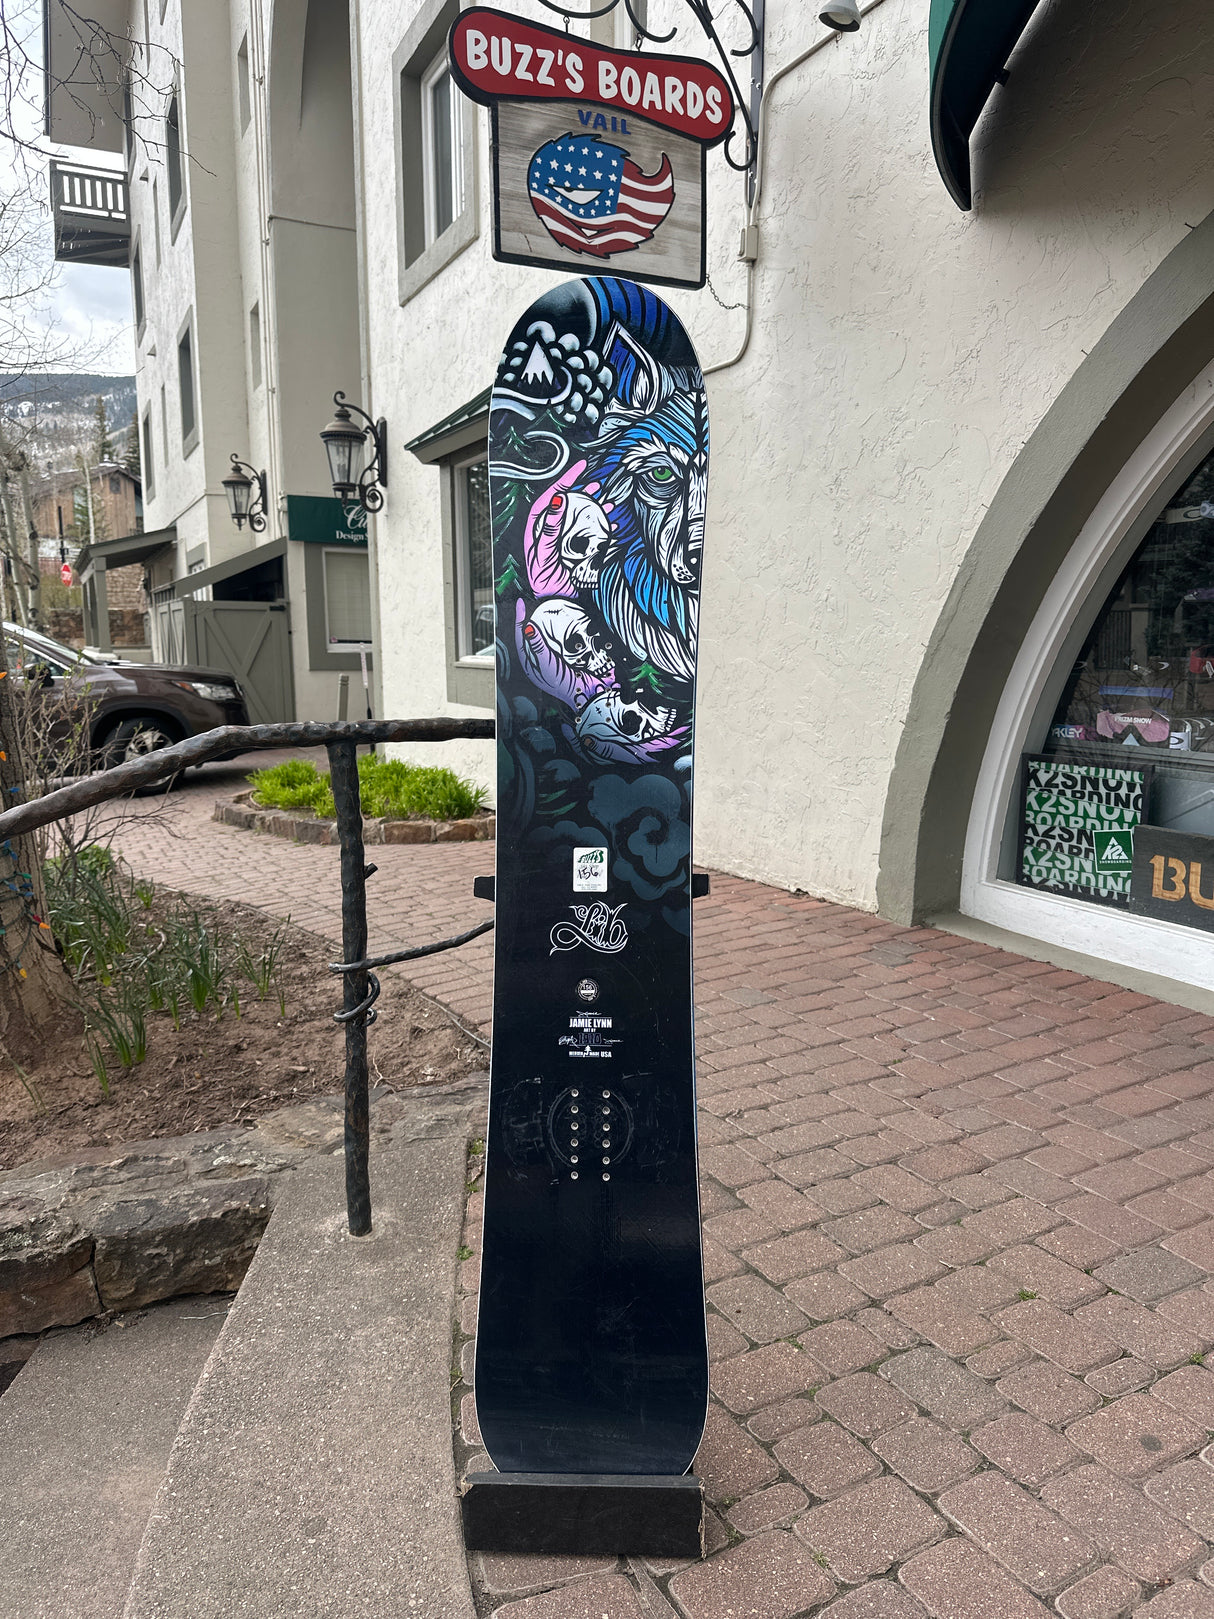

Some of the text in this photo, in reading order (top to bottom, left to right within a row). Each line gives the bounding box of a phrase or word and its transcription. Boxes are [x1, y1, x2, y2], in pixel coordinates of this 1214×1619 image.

[466, 29, 723, 124] BUZZ'S BOARDS
[577, 109, 632, 136] VAIL
[335, 530, 364, 543] Design
[1133, 717, 1152, 725] SNOW
[1051, 726, 1083, 739] AKLEY
[569, 1018, 612, 1029] JAMIE LYNN
